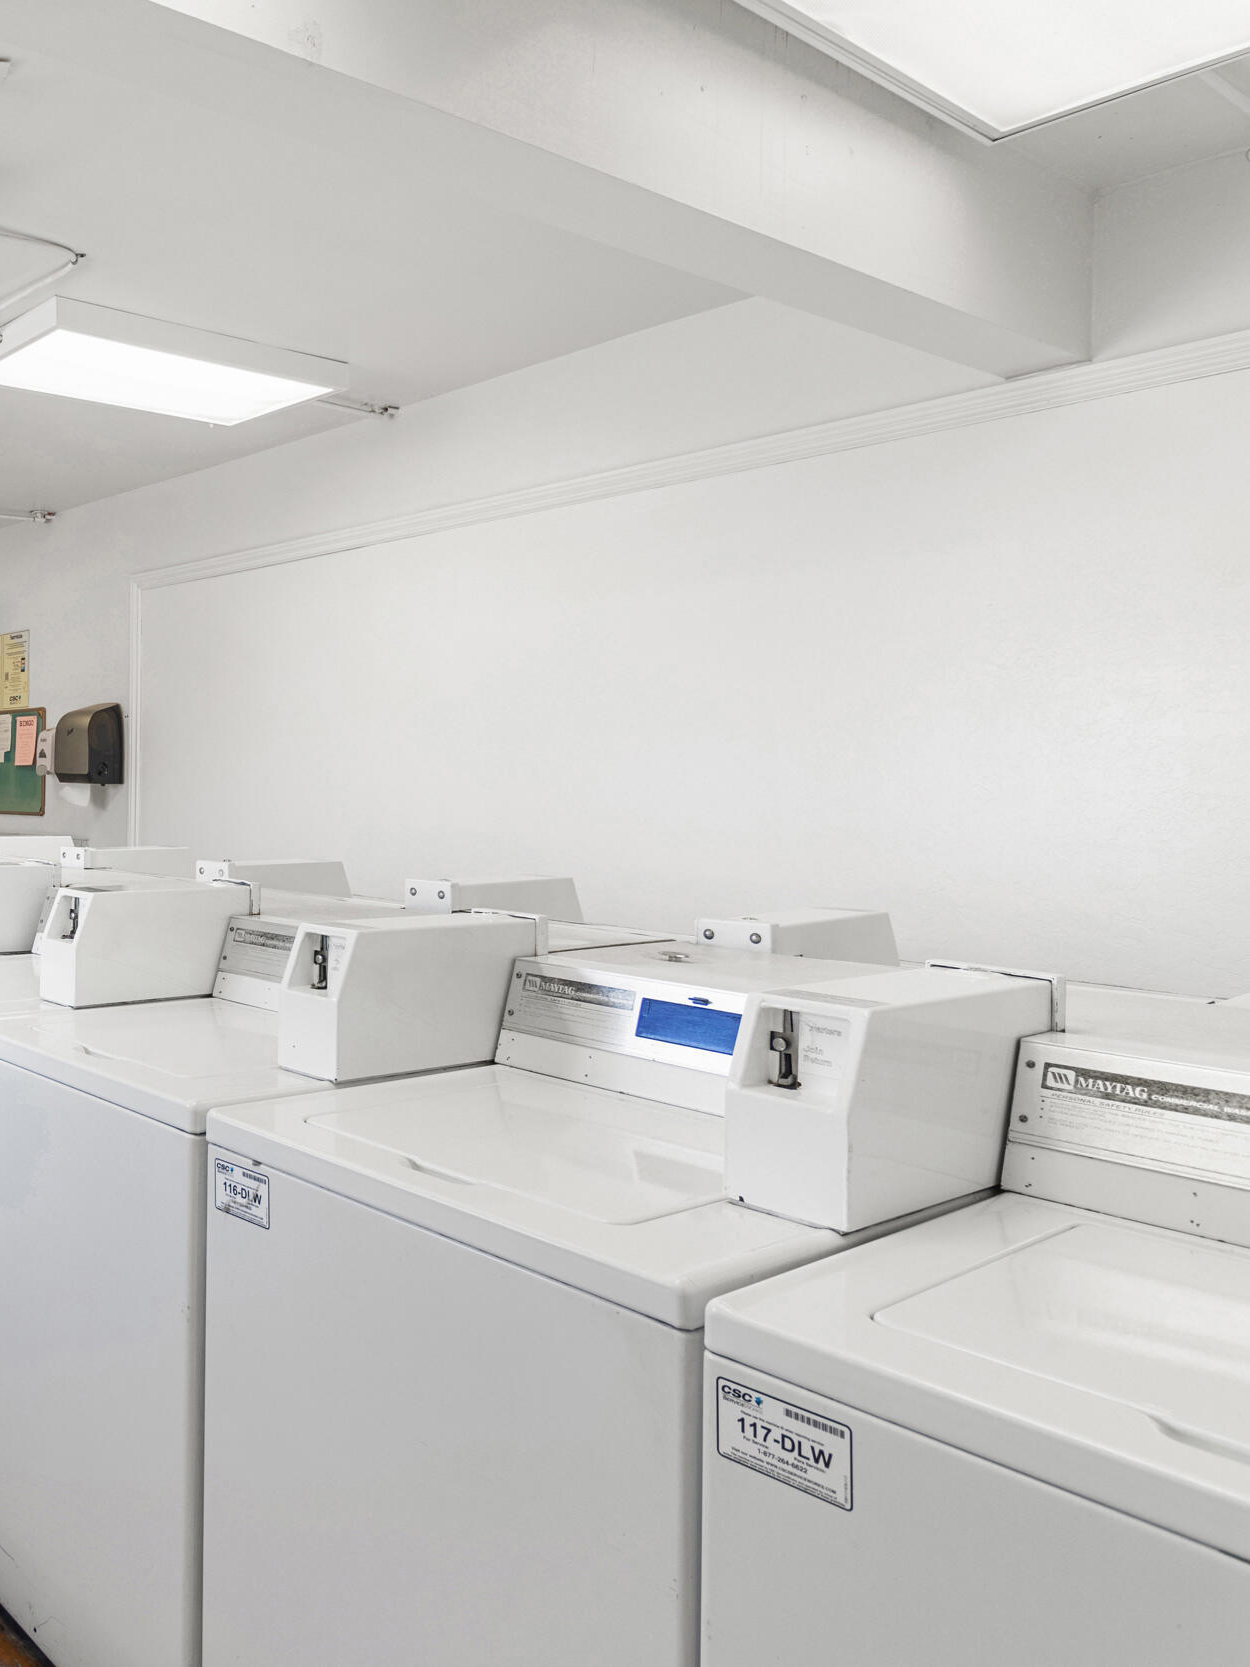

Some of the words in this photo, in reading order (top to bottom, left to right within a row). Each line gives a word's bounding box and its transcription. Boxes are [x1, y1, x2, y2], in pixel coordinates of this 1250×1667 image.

[540, 979, 575, 996] MAYTAG
[1050, 1092, 1097, 1106] PERSONAL
[1100, 1101, 1133, 1112] SAFETY
[1077, 1077, 1148, 1100] MAYTAG
[1152, 1094, 1222, 1112] COMMERCIAL
[216, 1162, 230, 1172] CSC
[722, 1384, 752, 1402] CSC
[737, 1417, 833, 1469] 117-DLW
